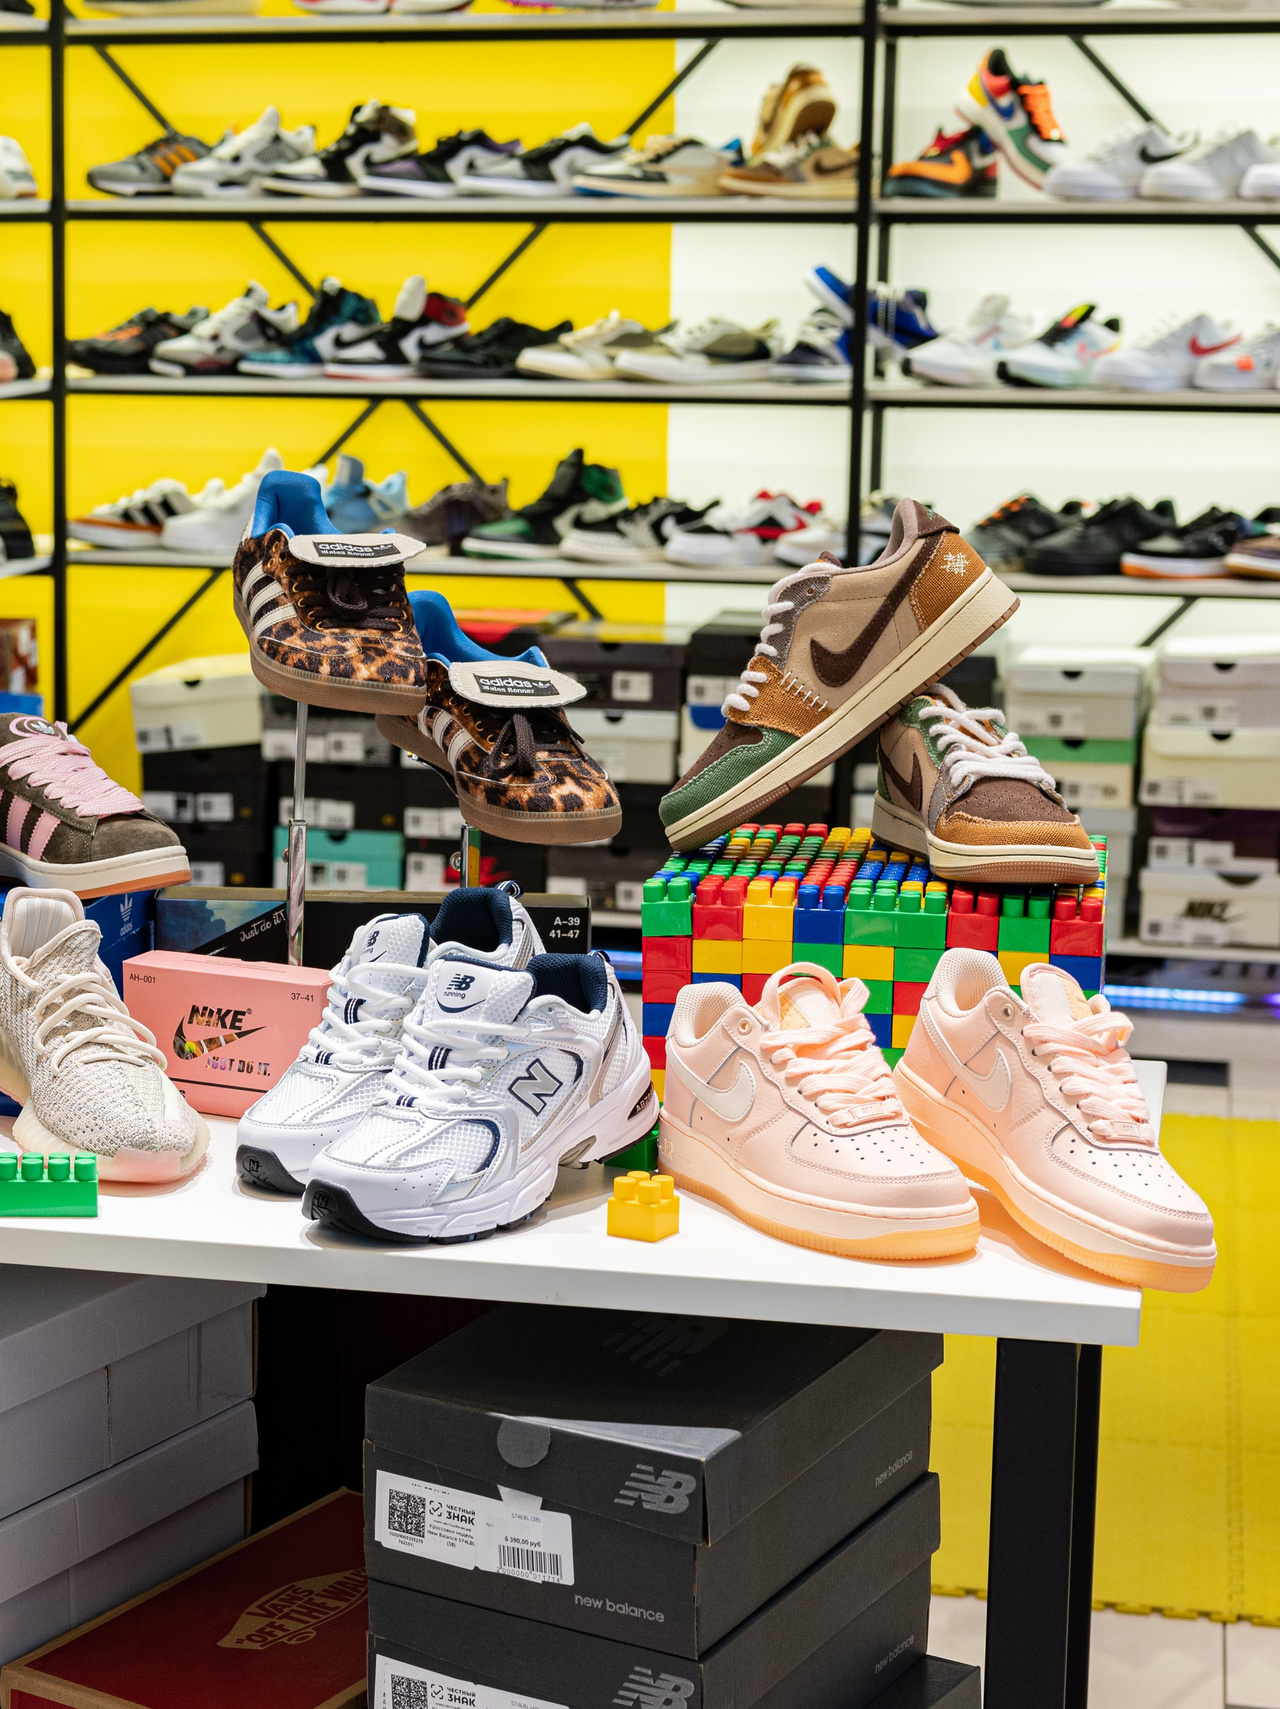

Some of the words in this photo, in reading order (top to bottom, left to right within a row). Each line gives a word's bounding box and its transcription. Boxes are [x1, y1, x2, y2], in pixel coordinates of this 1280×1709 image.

[318, 543, 373, 552] adidas
[480, 677, 533, 688] adidas
[482, 685, 506, 693] Wales
[554, 917, 580, 926] A-39
[240, 919, 262, 942] Just
[260, 919, 272, 932] do
[549, 930, 580, 939] 41-47
[129, 973, 156, 984] AH-001
[291, 993, 314, 1002] 37-41
[443, 990, 466, 1000] running
[187, 1004, 247, 1031] NIKE
[205, 1055, 235, 1072] JUST
[237, 1060, 254, 1074] DO
[257, 1062, 271, 1077] IT.
[874, 1468, 889, 1488] new
[888, 1450, 913, 1477] balance
[445, 1504, 476, 1516] ЧЕСТНЫЙ
[446, 1511, 476, 1526] ЗНАК
[245, 1584, 315, 1619] VANS
[574, 1593, 603, 1610] new
[606, 1598, 665, 1623] balance
[277, 1598, 342, 1625] THE
[874, 1652, 889, 1674] new
[888, 1634, 915, 1664] balance
[446, 1686, 476, 1698] ЧЕСТНЫЙ
[447, 1693, 476, 1707] ЗНАК
